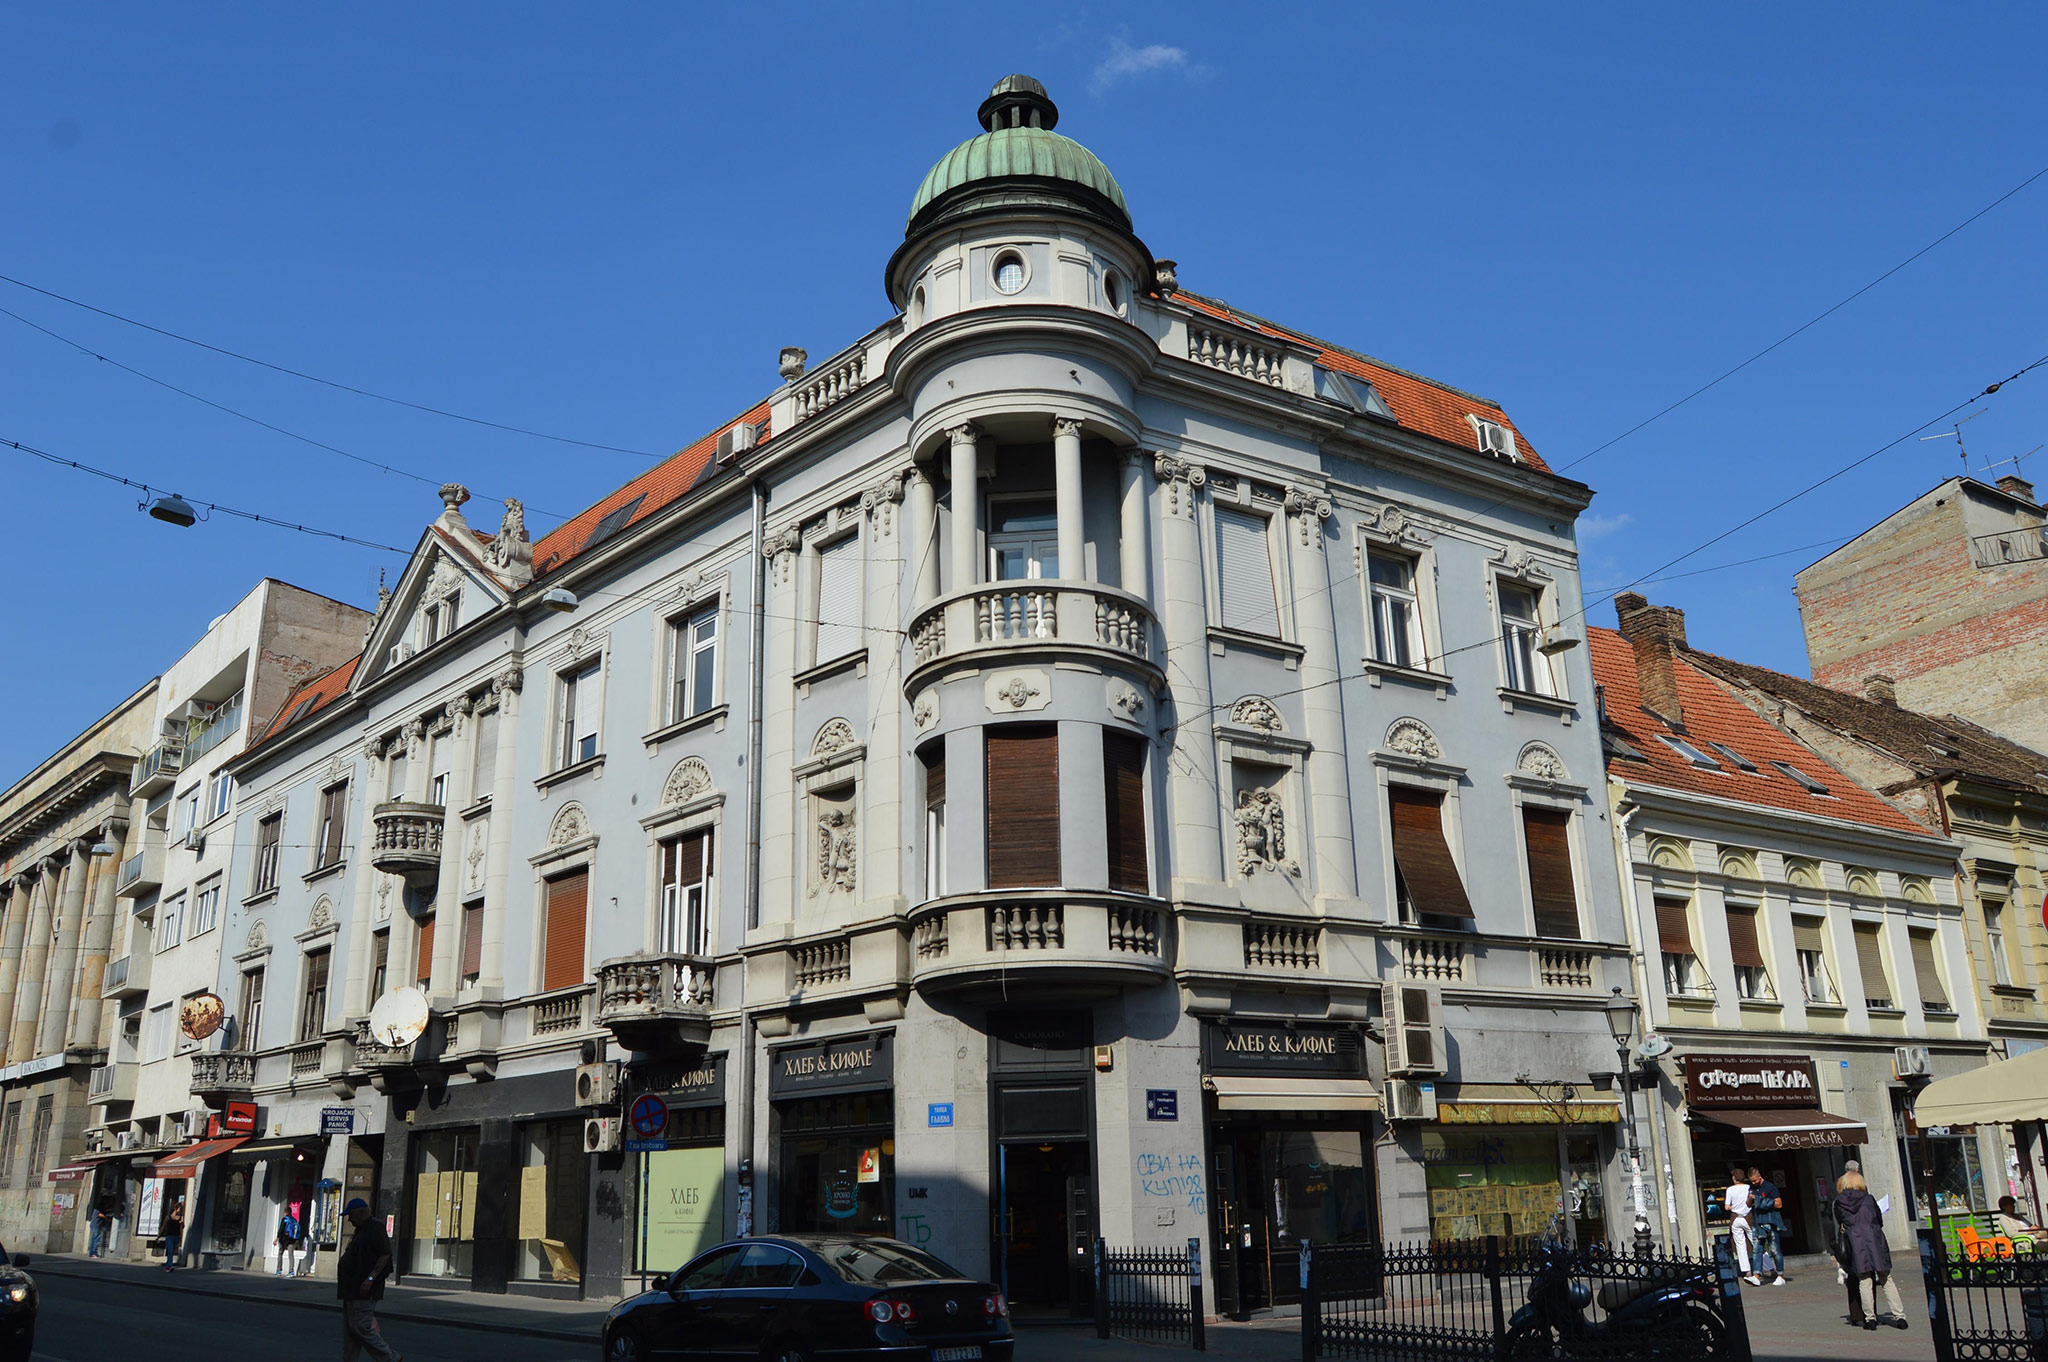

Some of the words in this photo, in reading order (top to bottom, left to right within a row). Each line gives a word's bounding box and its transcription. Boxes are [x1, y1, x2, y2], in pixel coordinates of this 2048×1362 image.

[1225, 1034, 1265, 1052] ХЛЕБ
[1268, 1035, 1282, 1053] &
[1285, 1036, 1336, 1054] КИФЛЕ
[785, 1056, 815, 1076] ХЛЕБ
[817, 1055, 828, 1072] &
[830, 1049, 872, 1070] КИФЛЕ
[681, 1069, 716, 1088] КИФЛЕ
[1699, 1069, 1739, 1089] СКРОЗ
[1761, 1070, 1812, 1089] ПЕКАРА
[1775, 1133, 1800, 1147] СКРОЗ
[1809, 1131, 1843, 1145] ПЕКАРА
[1137, 1153, 1171, 1176] СВИ
[1178, 1153, 1202, 1171] НА
[670, 1187, 699, 1205] ХЛЕБ
